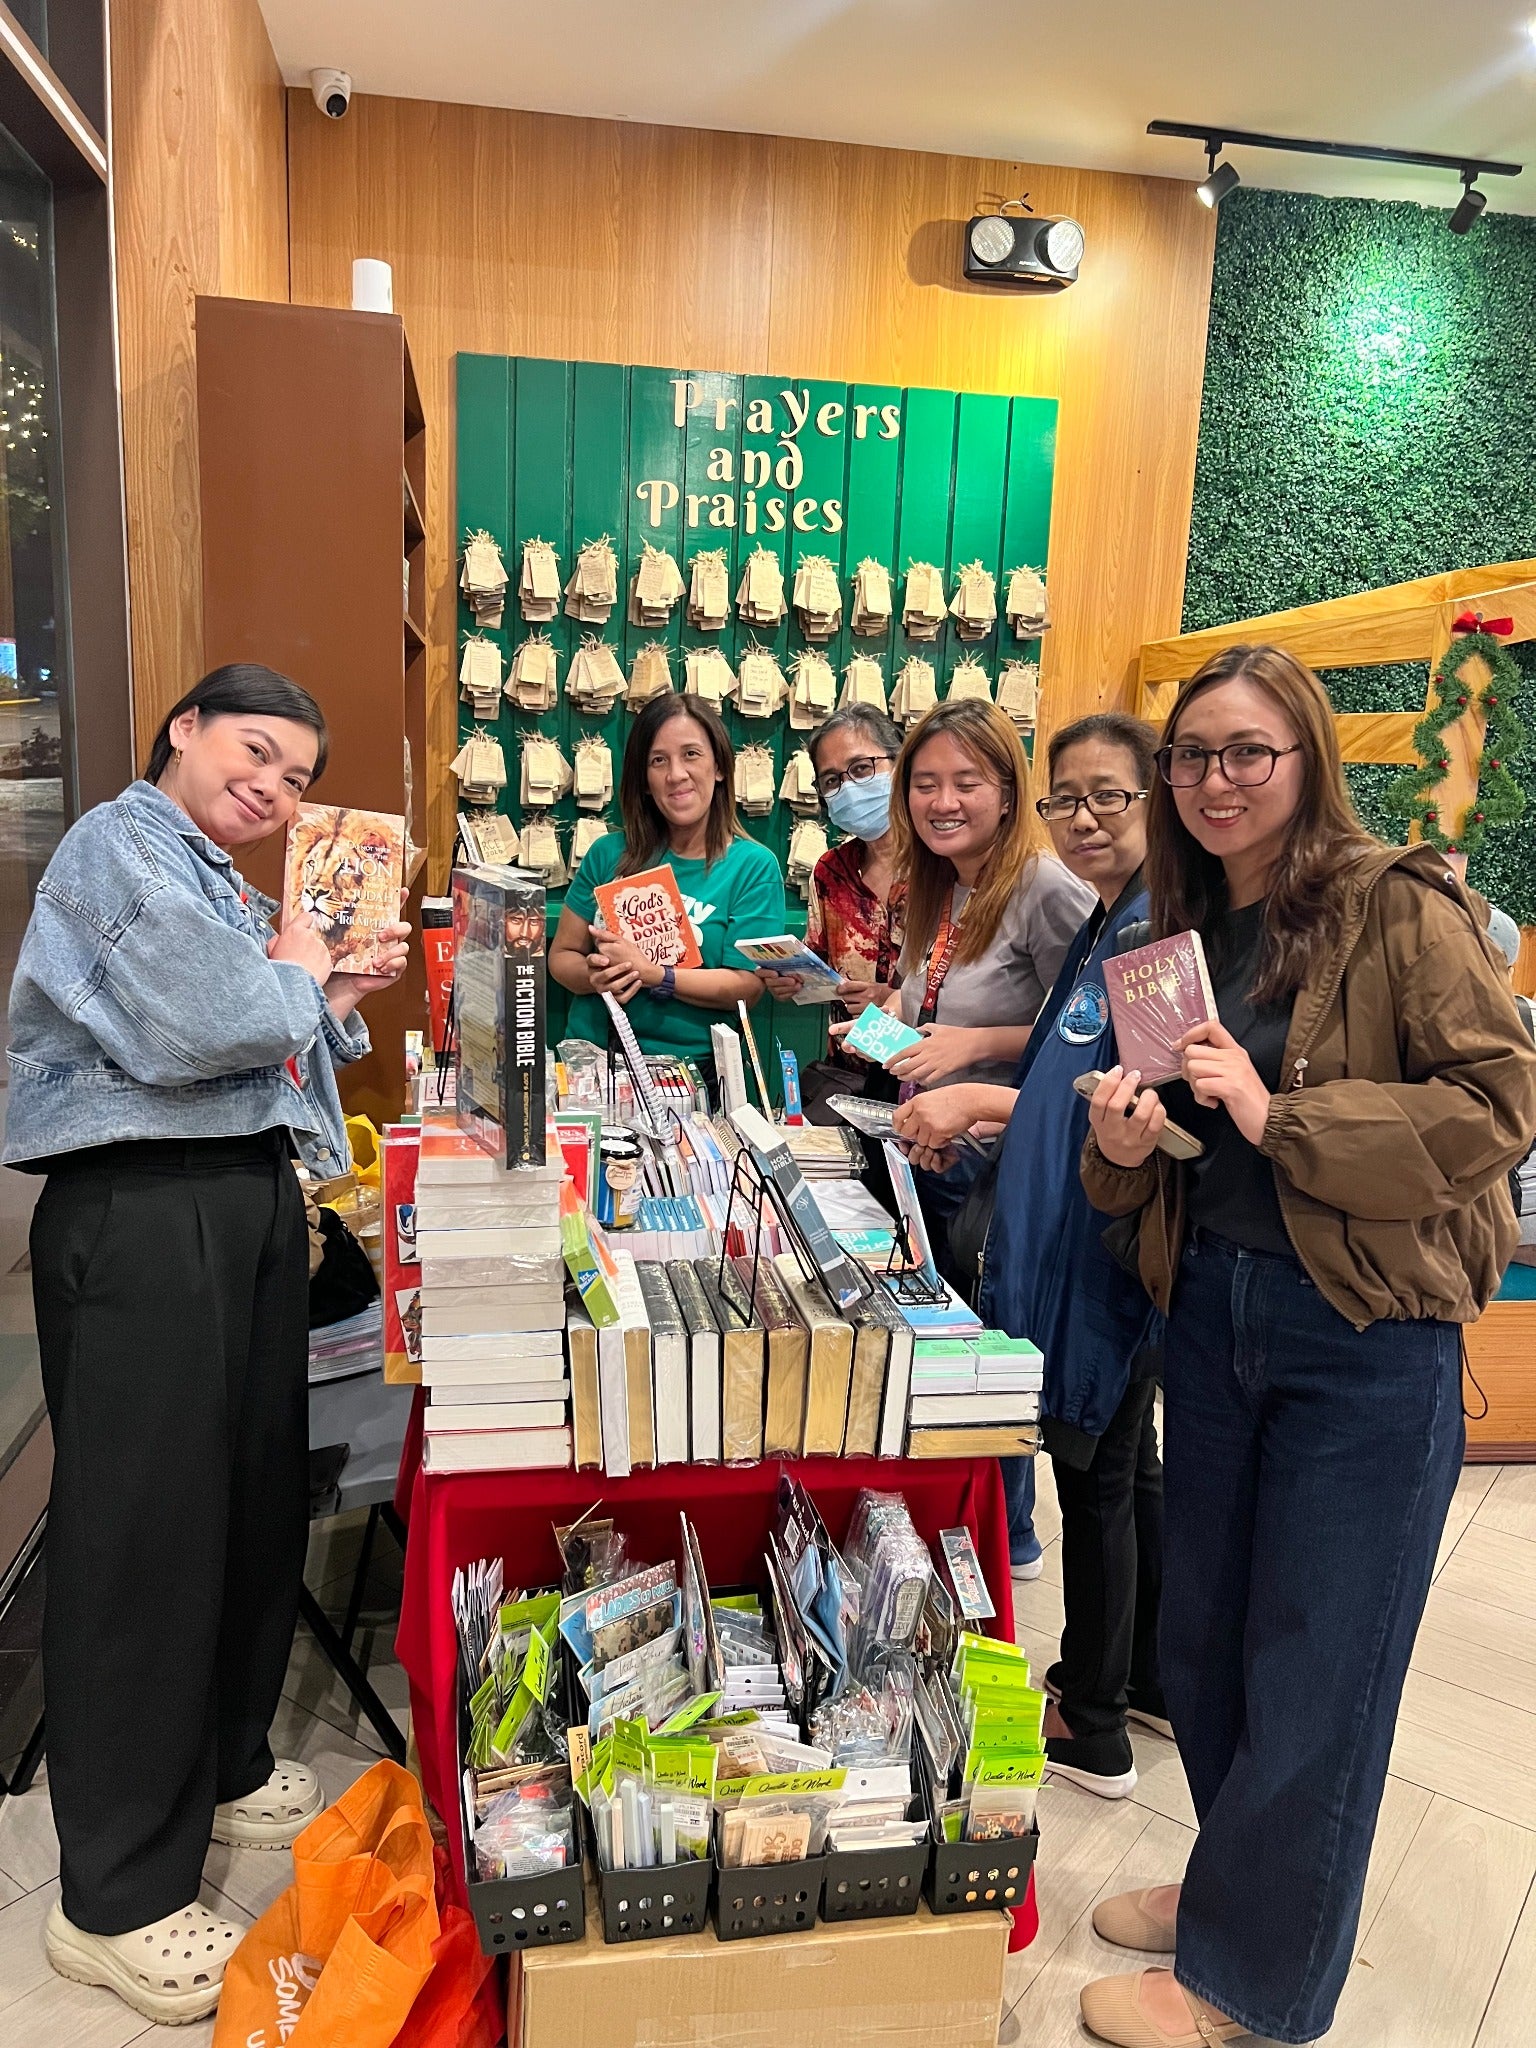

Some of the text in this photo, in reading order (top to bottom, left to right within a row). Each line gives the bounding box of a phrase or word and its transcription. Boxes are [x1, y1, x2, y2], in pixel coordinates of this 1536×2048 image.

[669, 379, 900, 440] Prayers
[706, 440, 804, 490] and
[636, 480, 843, 535] Praises
[340, 856, 394, 878] LION
[352, 889, 394, 903] JUDAH
[622, 892, 663, 919] God's
[626, 908, 668, 930] NOT
[633, 922, 673, 942] DONE
[659, 931, 676, 943] YOU
[516, 964, 535, 976] THE
[1121, 955, 1177, 987] HOLY
[515, 978, 536, 1068] ACTION BIBLE
[879, 1015, 905, 1041] life
[850, 1027, 896, 1061] ridge
[770, 1151, 789, 1166] HOLY
[773, 1156, 793, 1171] BIBLE
[600, 1587, 641, 1622] LADIES
[803, 1777, 833, 1791] Work
[1014, 1770, 1036, 1781] Work
